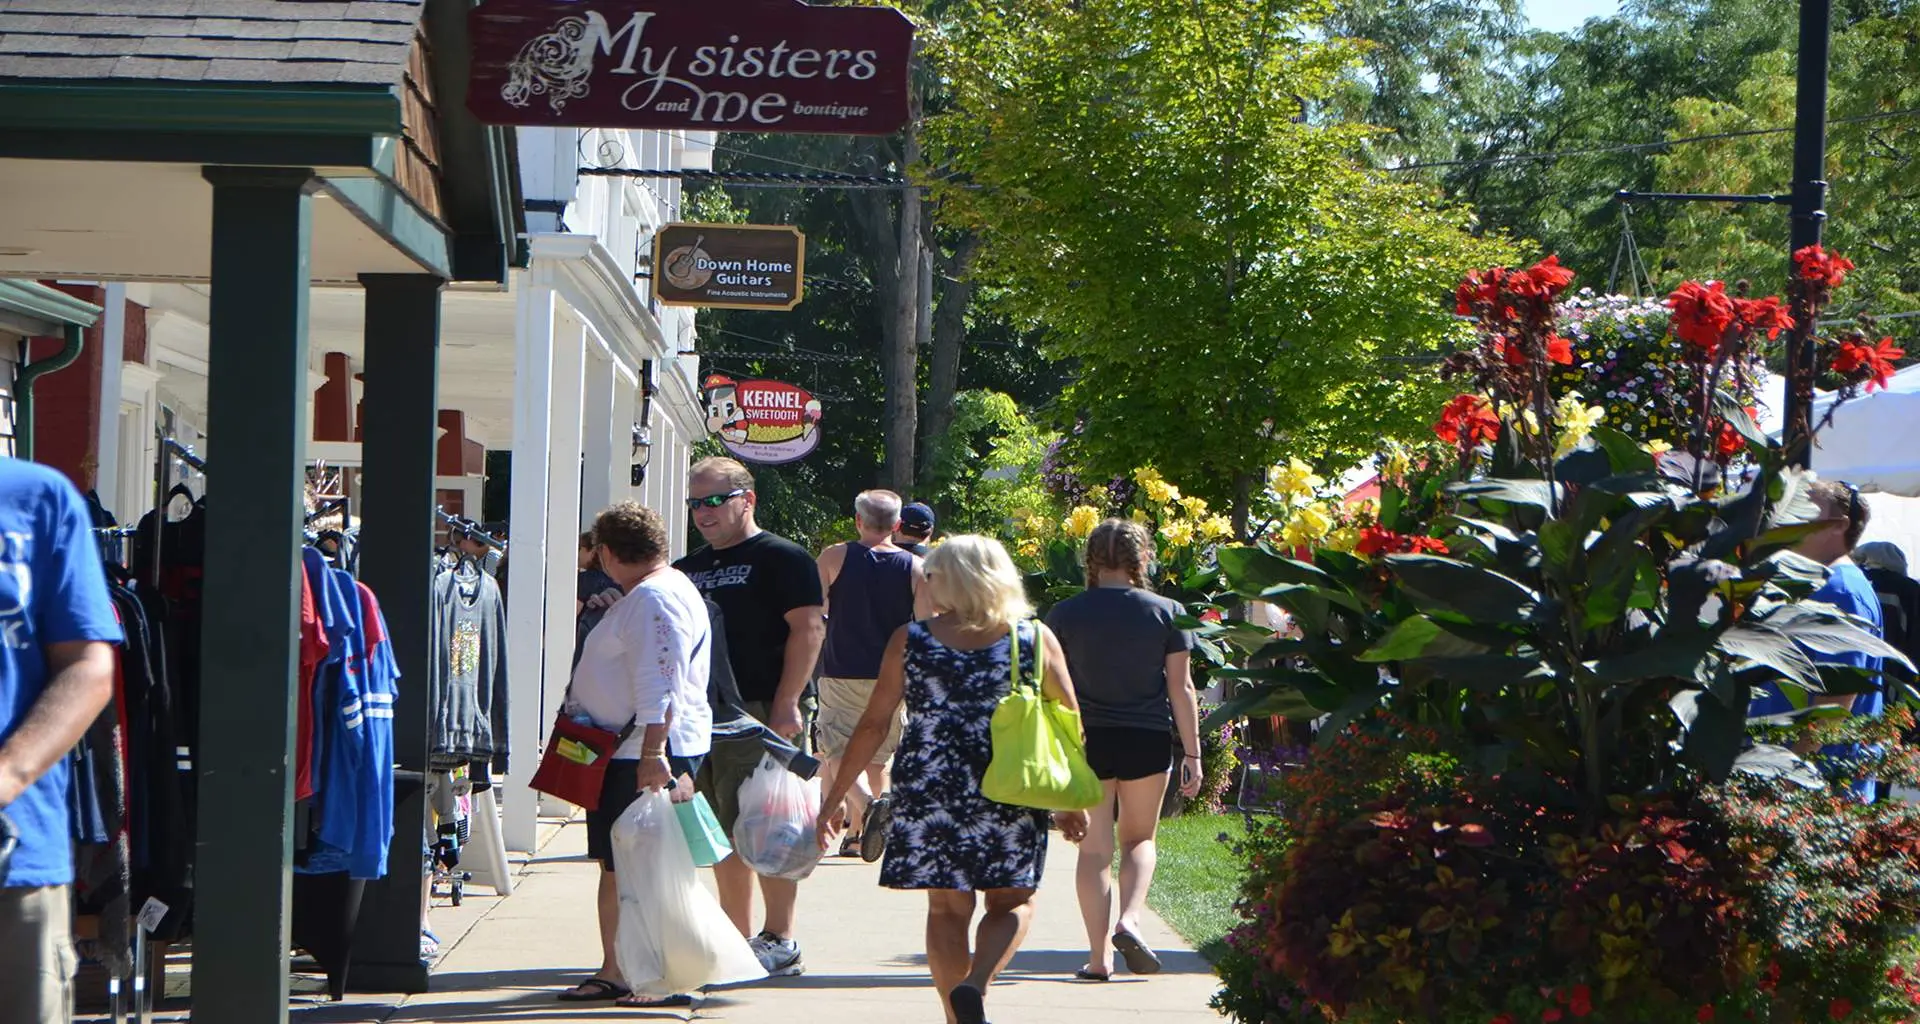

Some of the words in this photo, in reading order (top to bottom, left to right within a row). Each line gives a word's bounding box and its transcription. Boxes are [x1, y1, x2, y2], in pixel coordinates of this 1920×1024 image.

[584, 10, 678, 110] My
[688, 35, 877, 81] sisters
[655, 98, 690, 113] and
[690, 86, 787, 124] me
[793, 101, 869, 118] boutique
[697, 259, 742, 271] Down
[747, 260, 792, 272] Home
[716, 273, 772, 286] Guitars
[743, 390, 803, 409] KERNEL
[746, 409, 798, 420] SWEETOOTH
